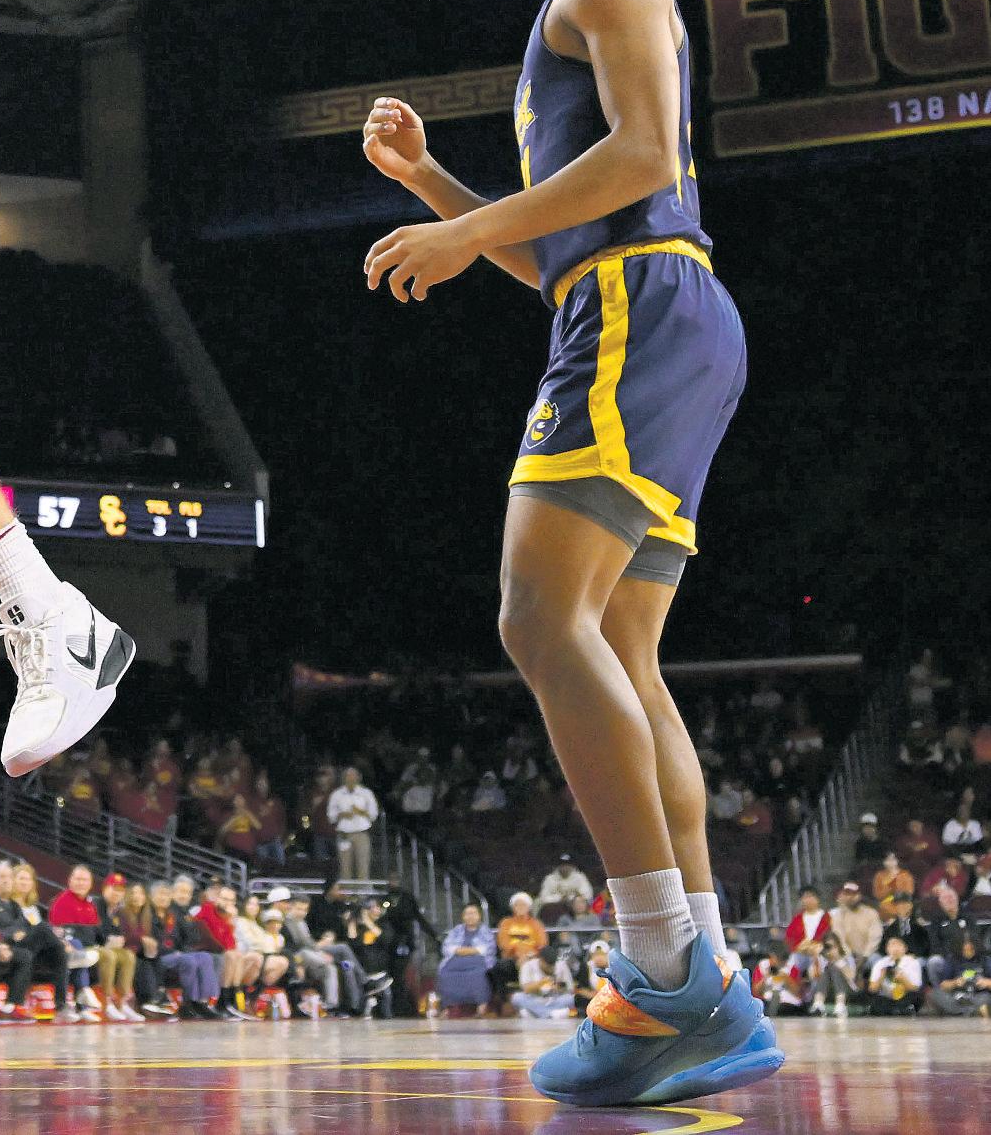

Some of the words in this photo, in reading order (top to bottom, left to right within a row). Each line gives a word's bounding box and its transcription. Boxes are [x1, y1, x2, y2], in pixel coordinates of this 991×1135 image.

[888, 96, 945, 124] 138
[37, 495, 81, 529] 57
[152, 516, 167, 537] 3
[185, 518, 198, 539] 1
